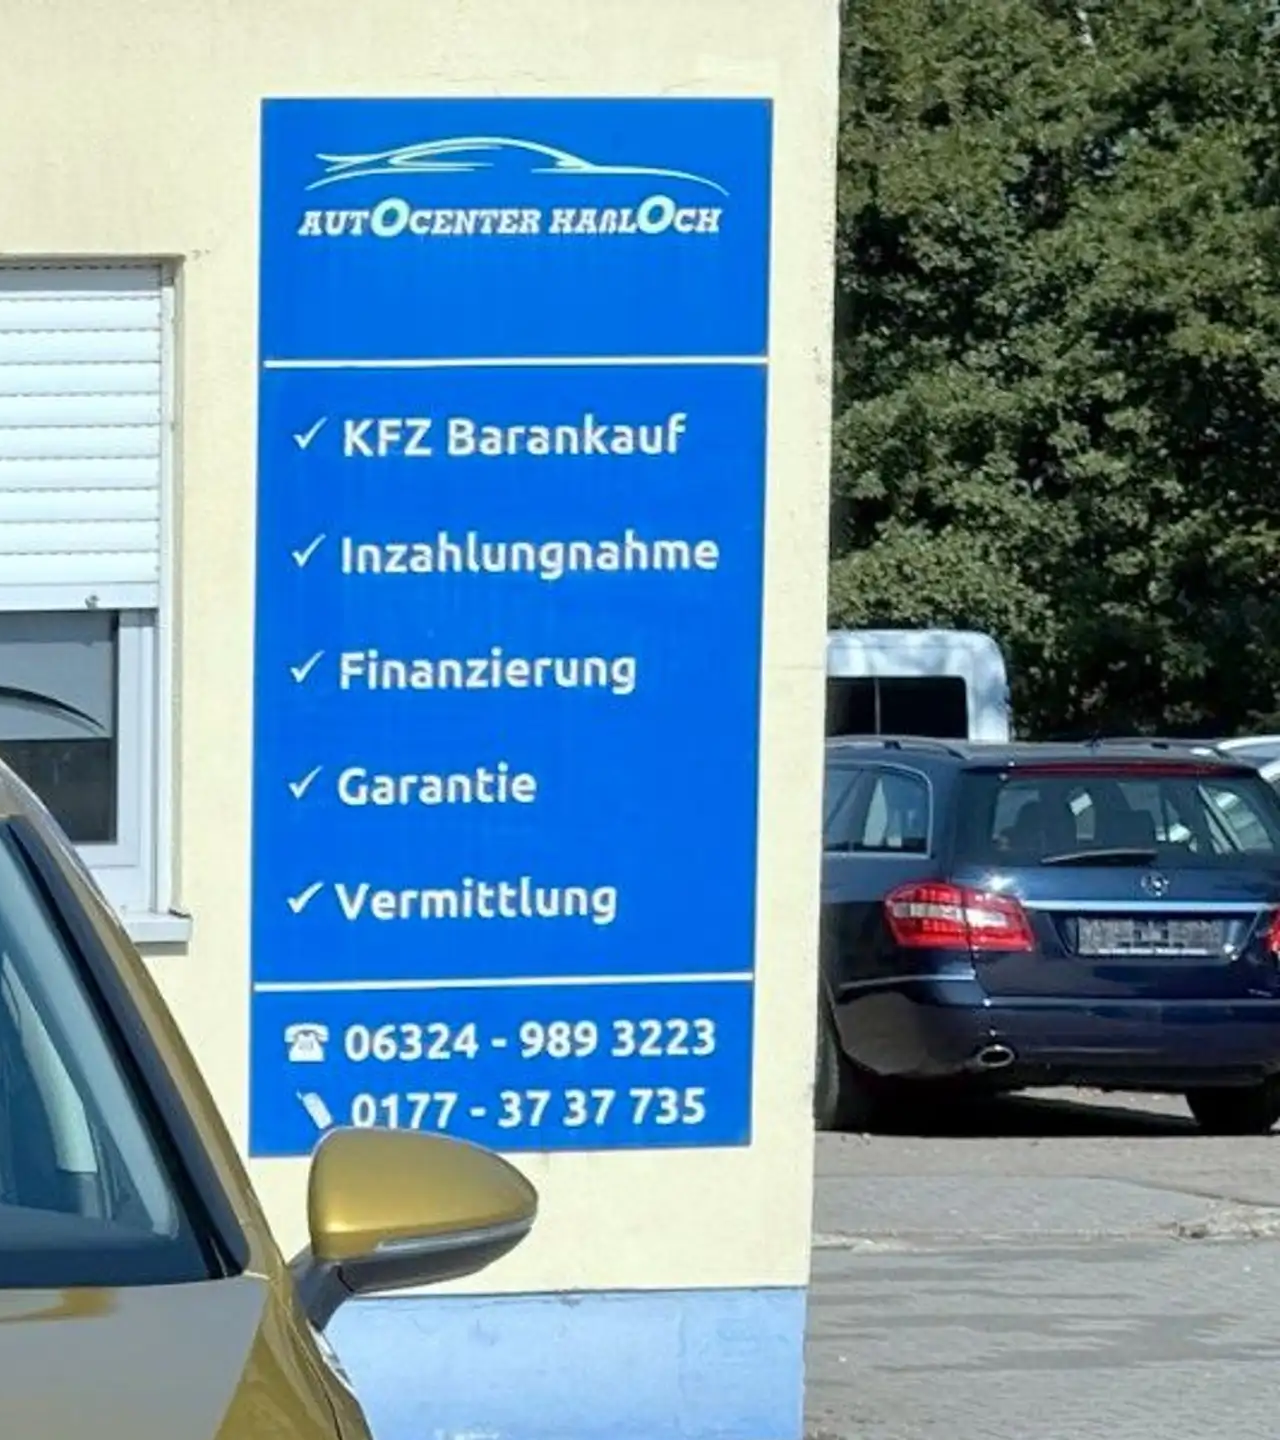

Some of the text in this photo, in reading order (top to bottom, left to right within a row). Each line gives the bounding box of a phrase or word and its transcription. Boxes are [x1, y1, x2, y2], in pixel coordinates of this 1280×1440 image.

[298, 198, 542, 237] AUTOCENTER
[344, 413, 686, 456] KFZ Barankauf
[342, 530, 719, 580] Inzahlungnahme
[340, 647, 636, 695] Finanzierung
[338, 762, 536, 805] Garantie
[335, 877, 616, 925] Vermittlung
[345, 1022, 479, 1061] 06324
[520, 1021, 598, 1058] 989
[612, 1018, 715, 1057] 3223
[350, 1093, 457, 1129] 0177
[498, 1090, 551, 1128] 37
[564, 1089, 615, 1126] 37
[629, 1087, 705, 1124] 735
